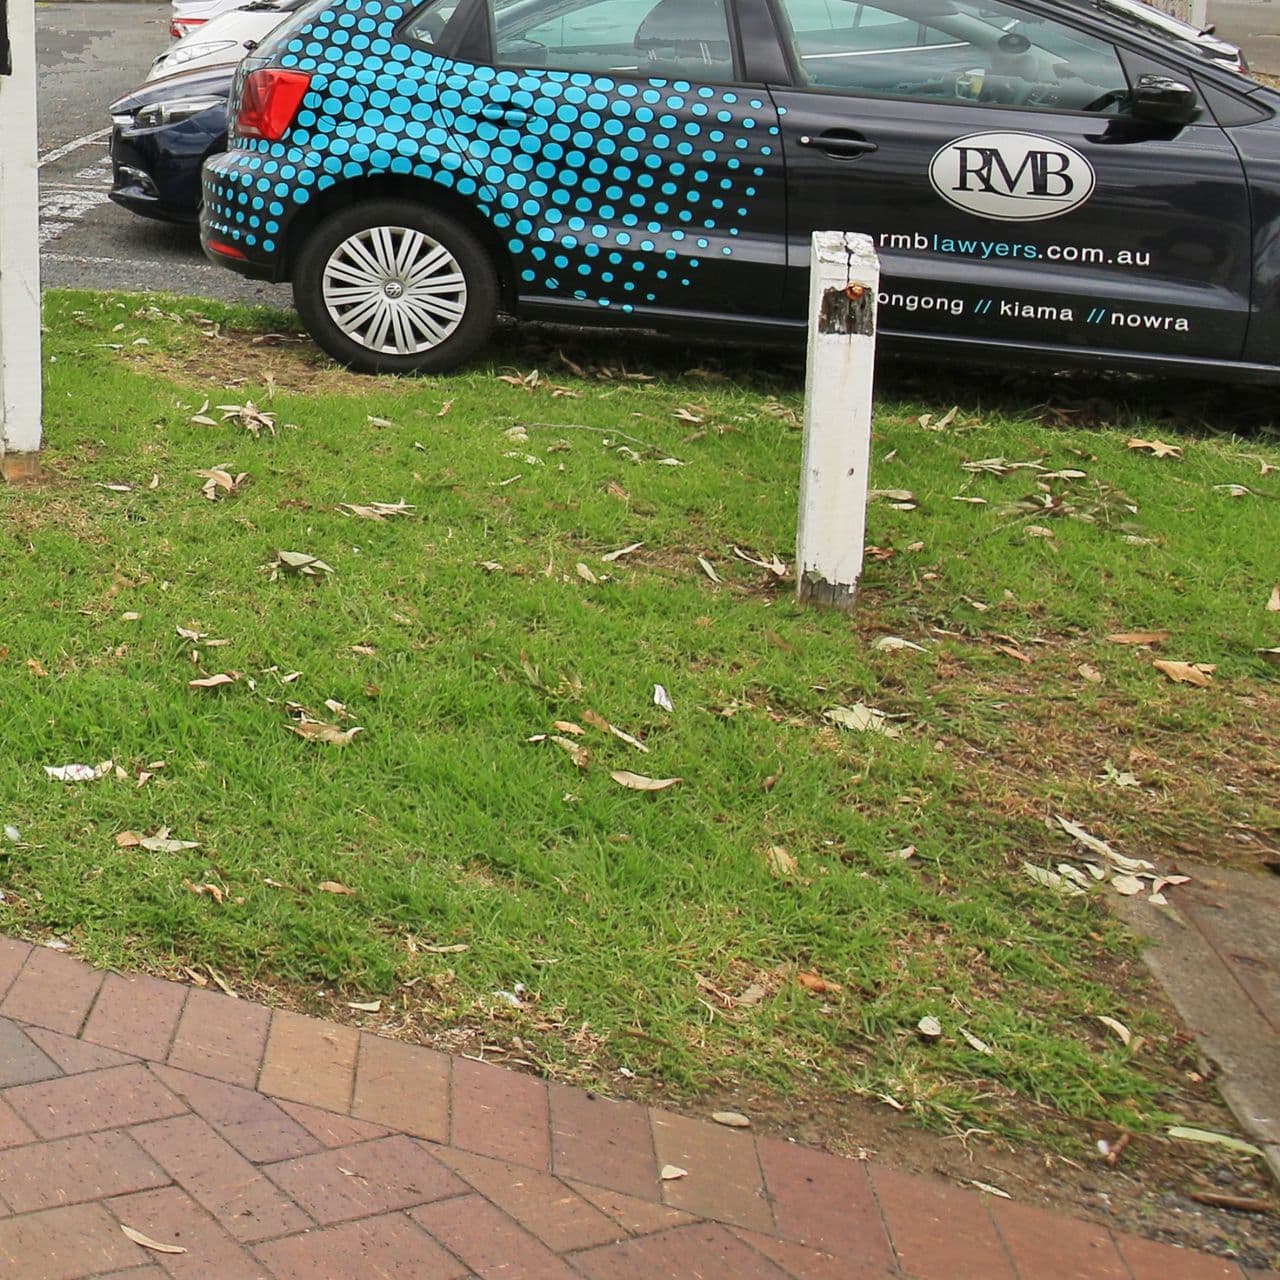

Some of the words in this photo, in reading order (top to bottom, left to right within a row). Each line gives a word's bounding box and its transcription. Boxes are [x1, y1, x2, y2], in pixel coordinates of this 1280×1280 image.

[952, 146, 1074, 202] RMB
[879, 232, 1151, 266] rmblawyers.com.au
[877, 292, 964, 315] ongong
[1000, 300, 1073, 321] kiama
[1110, 312, 1190, 332] nowra
